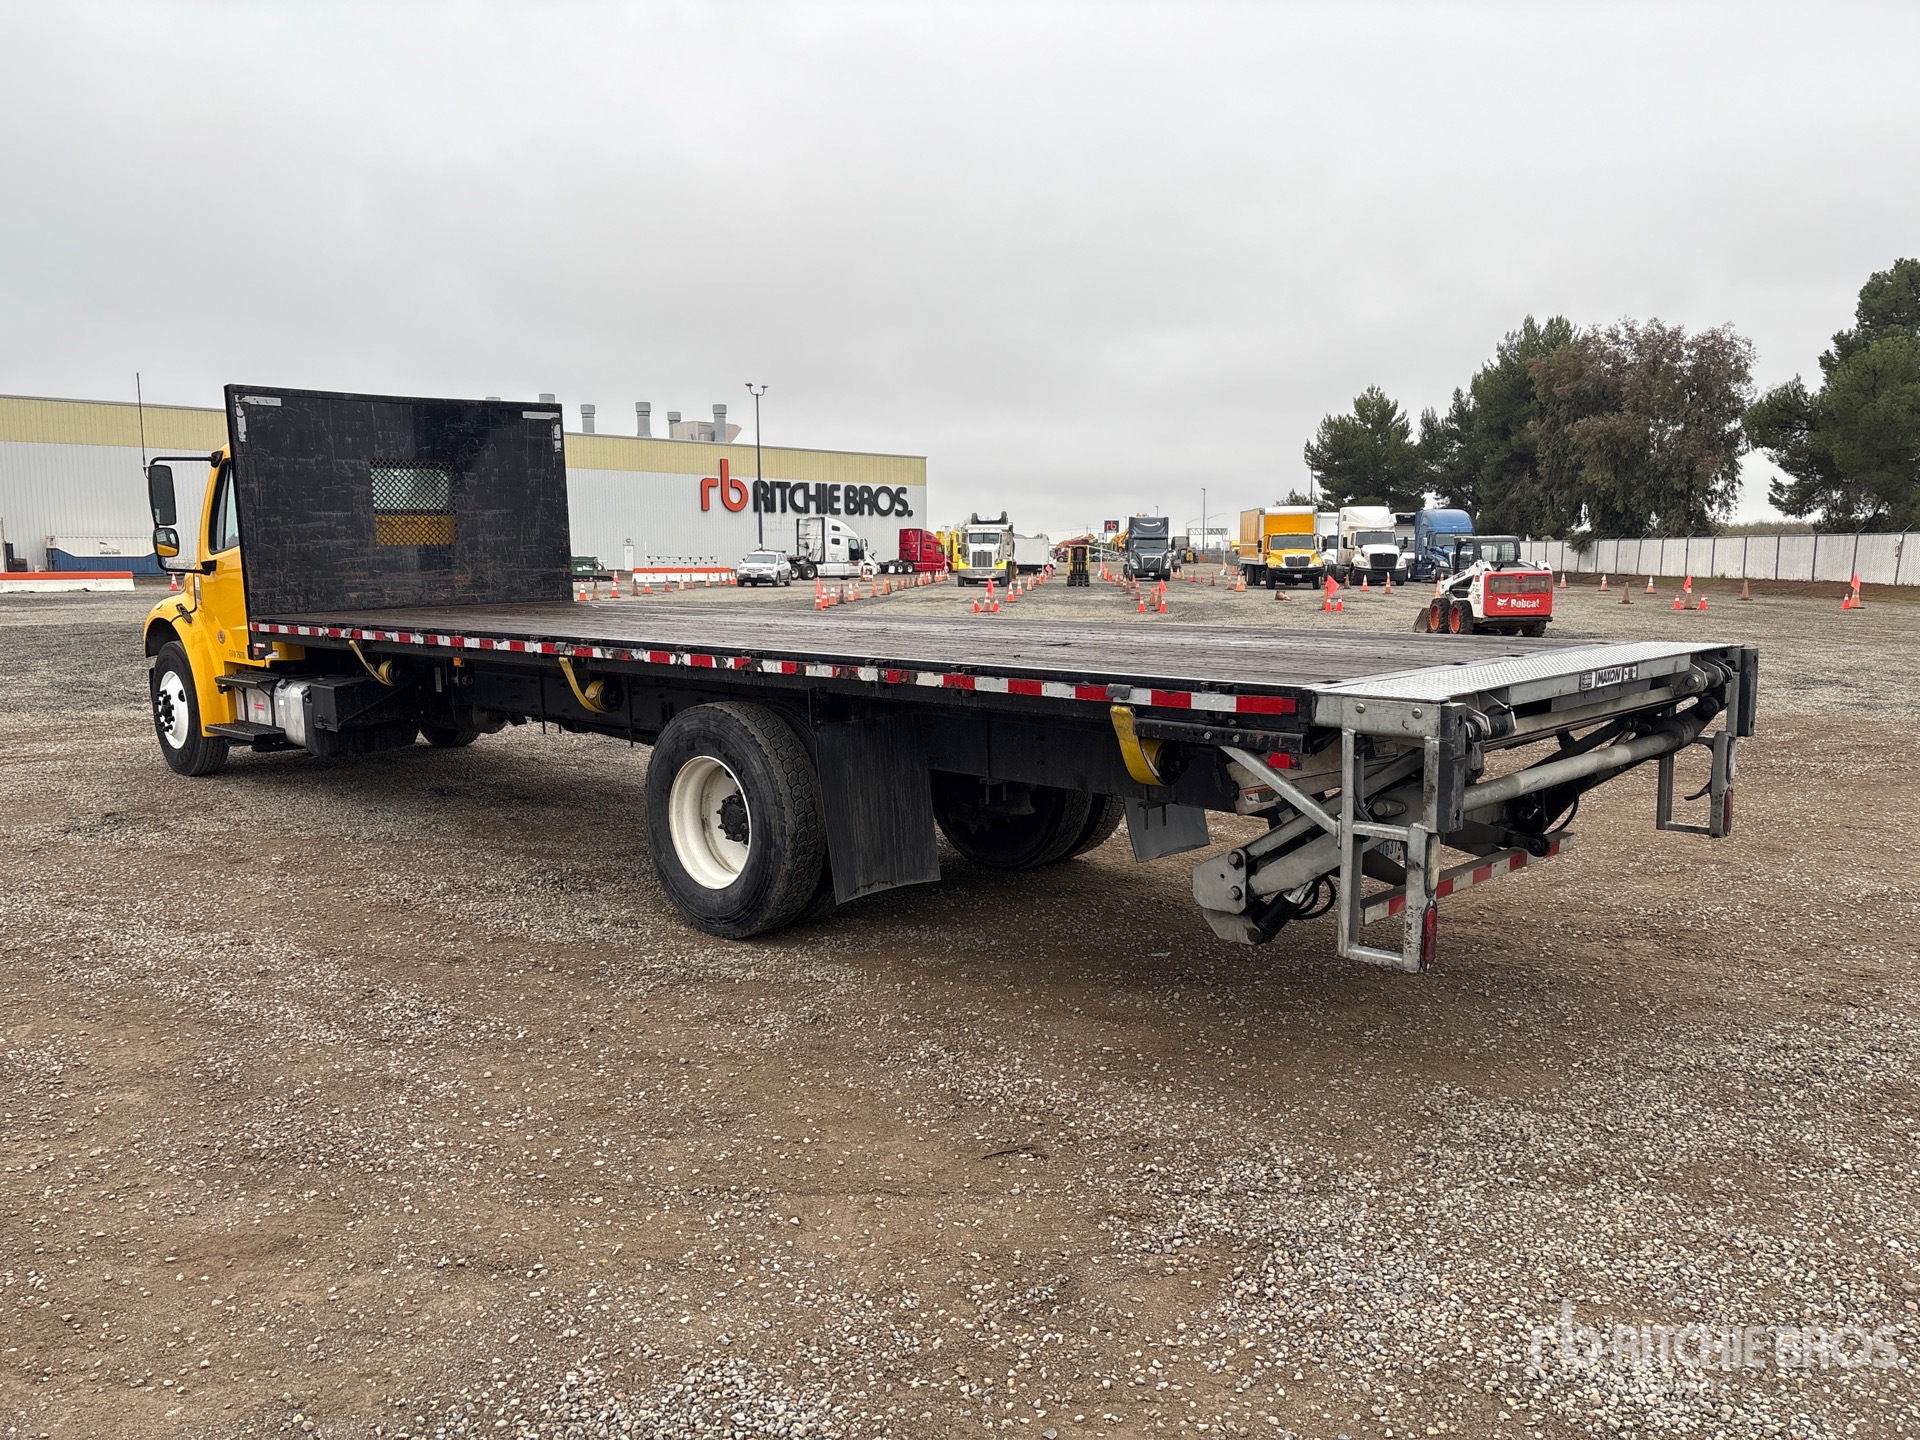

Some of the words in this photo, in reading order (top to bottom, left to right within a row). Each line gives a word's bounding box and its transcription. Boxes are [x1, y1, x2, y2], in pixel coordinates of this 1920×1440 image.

[700, 458, 748, 512] rb
[752, 480, 841, 515] RITCHIE
[844, 485, 914, 517] BROS.
[1511, 599, 1540, 608] Bobcat
[1597, 668, 1622, 685] MAXON
